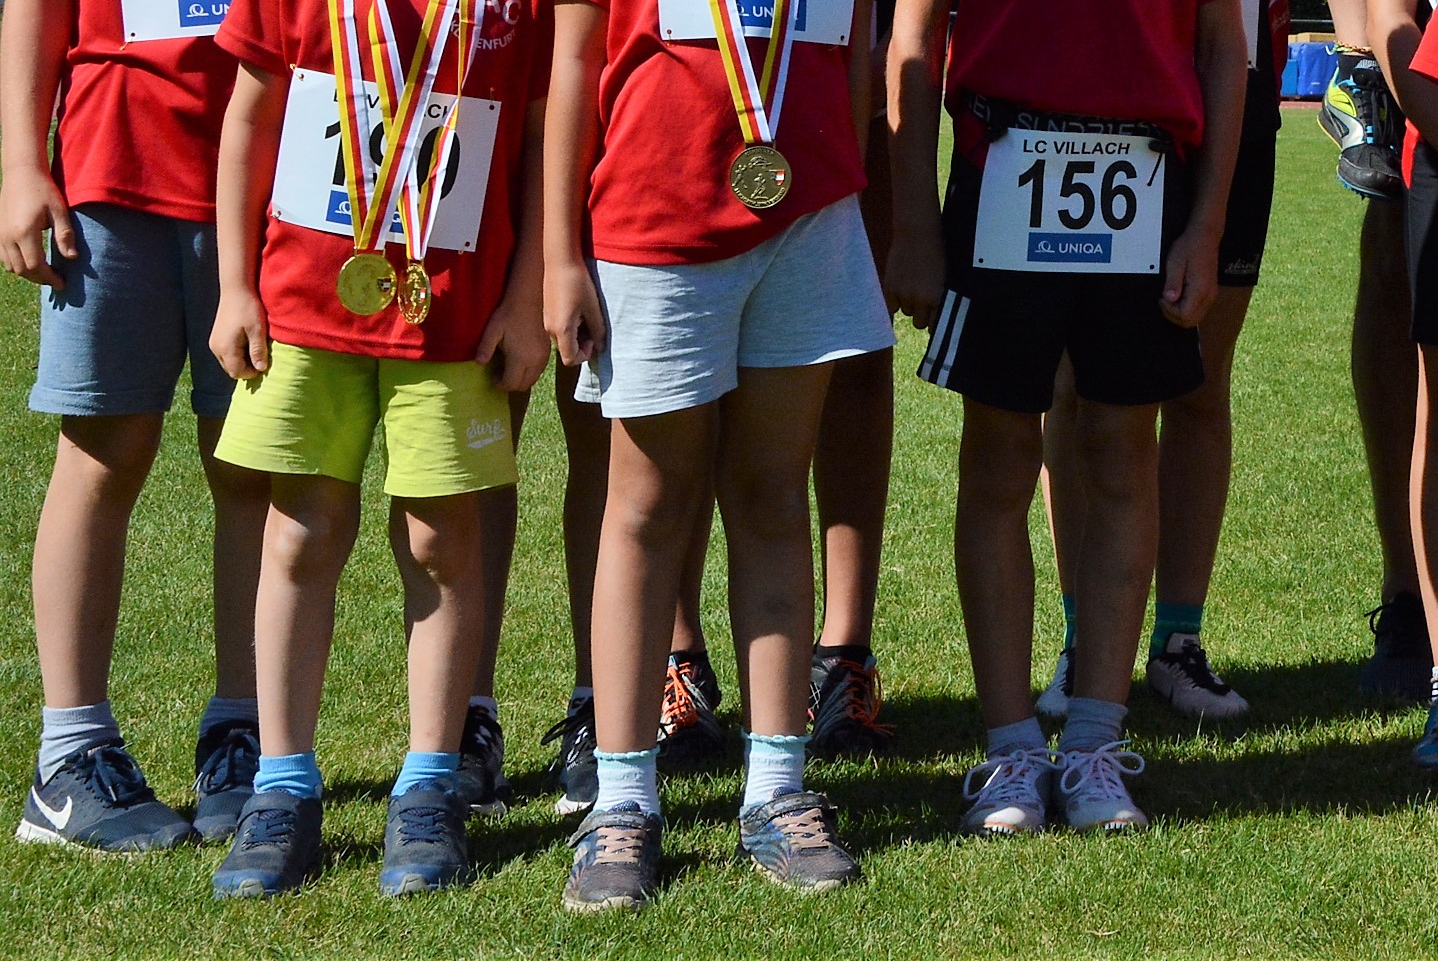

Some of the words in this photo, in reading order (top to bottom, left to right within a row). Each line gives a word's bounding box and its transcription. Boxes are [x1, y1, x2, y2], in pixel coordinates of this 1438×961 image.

[1023, 139, 1048, 154] LC
[1053, 141, 1131, 155] VILLACH
[1017, 159, 1138, 231] 156
[1058, 242, 1103, 254] UNIQA
